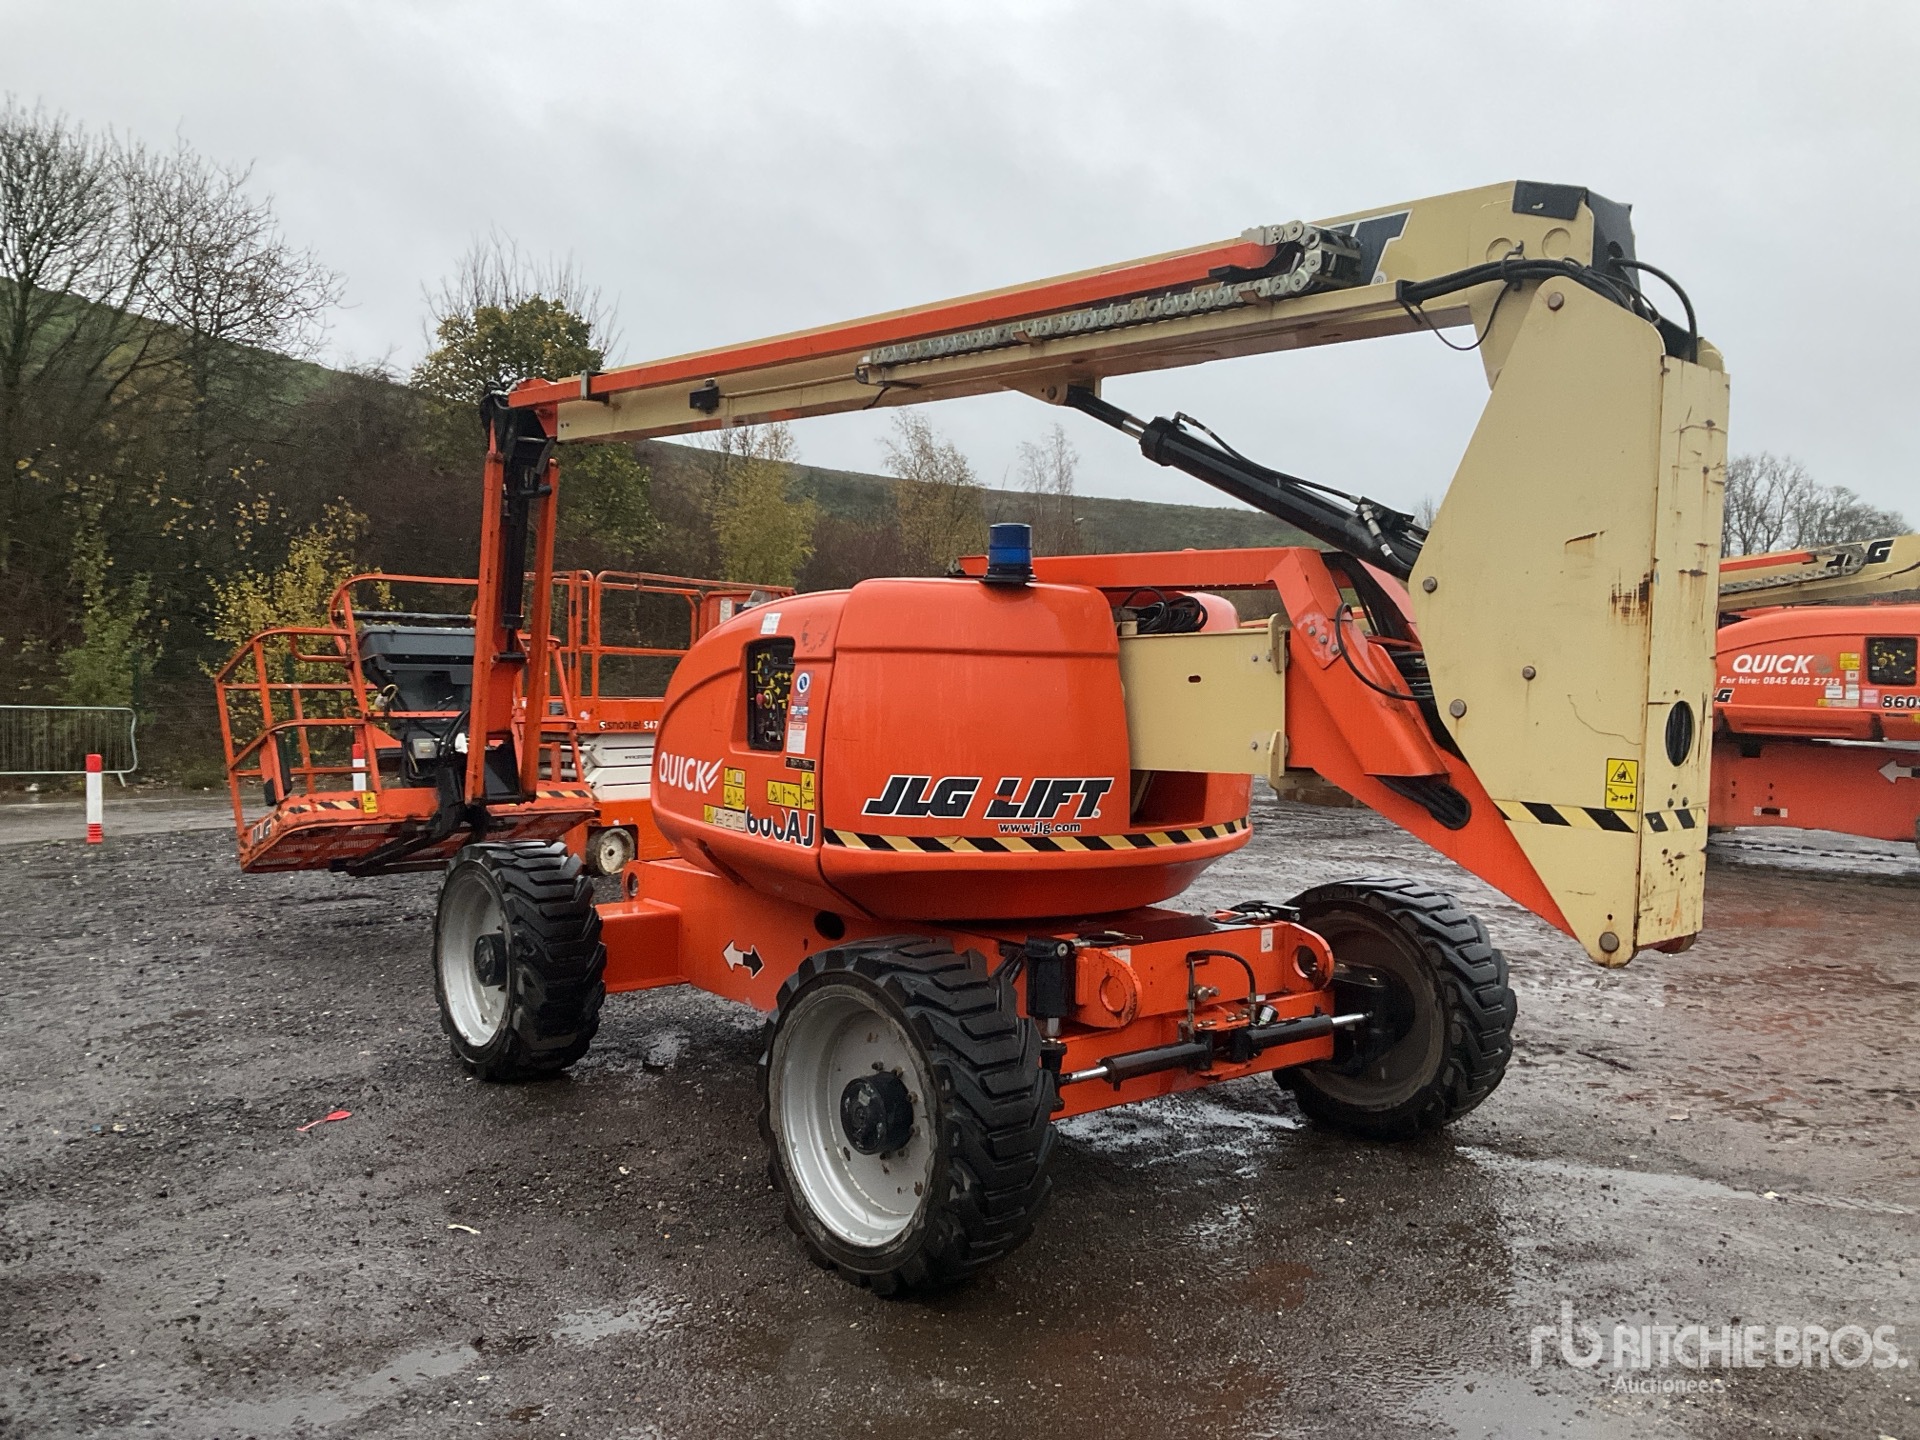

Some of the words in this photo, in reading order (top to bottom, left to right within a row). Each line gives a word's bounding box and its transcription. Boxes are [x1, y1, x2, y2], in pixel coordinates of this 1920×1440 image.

[1732, 654, 1814, 674] QUICK
[1720, 675, 1736, 685] For
[1738, 676, 1760, 685] hire:
[1763, 676, 1788, 685] 0845
[1791, 677, 1810, 686] 602
[1813, 677, 1840, 686] 2733
[1880, 694, 1920, 709] 860
[658, 751, 711, 794] QUICK
[861, 775, 983, 818] JLG
[983, 777, 1114, 819] LIFT
[998, 822, 1081, 835] www.jlg.com
